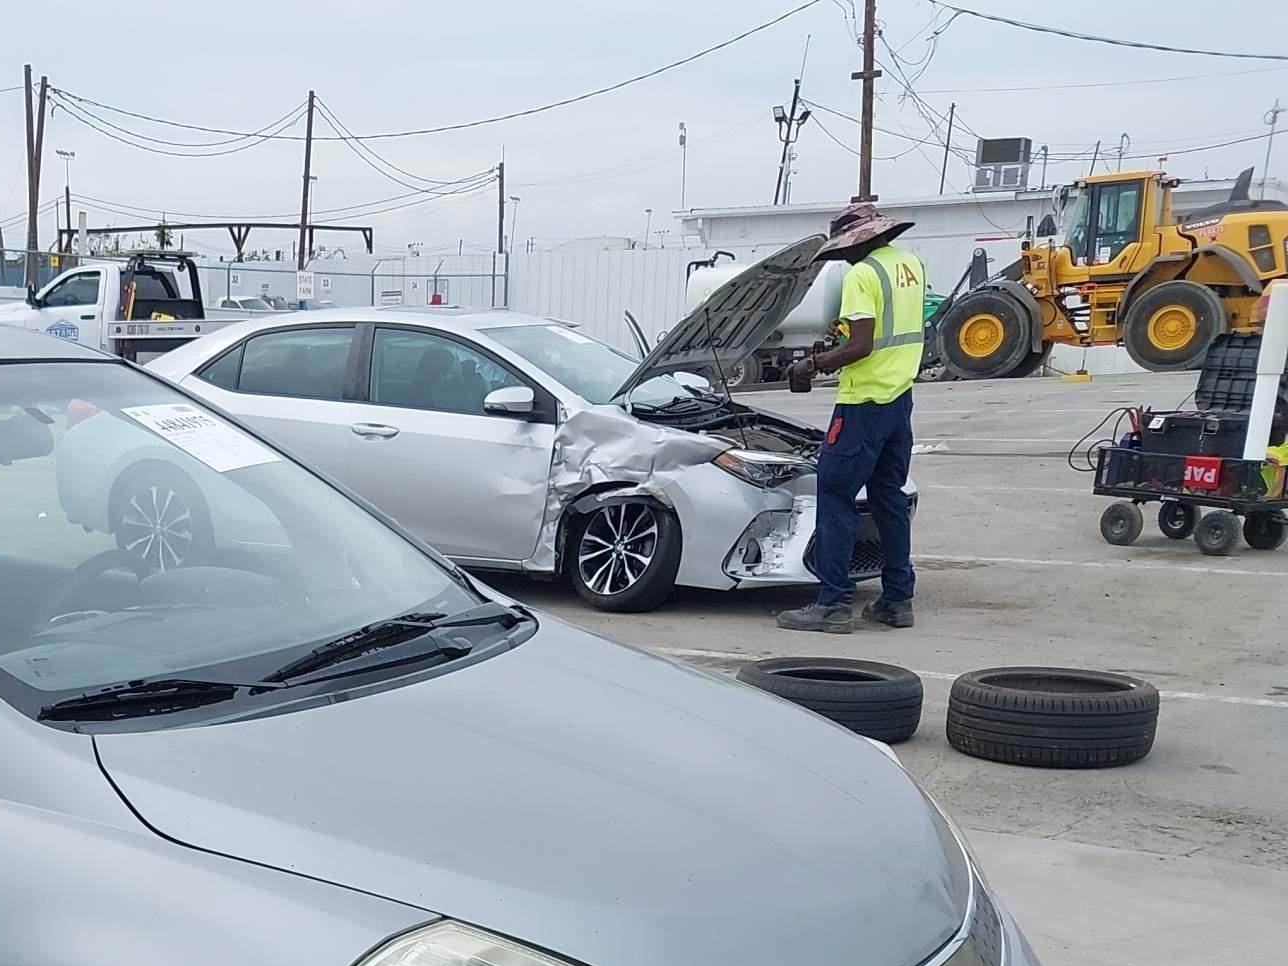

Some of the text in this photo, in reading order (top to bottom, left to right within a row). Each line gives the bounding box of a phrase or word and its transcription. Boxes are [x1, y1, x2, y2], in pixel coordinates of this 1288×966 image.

[1185, 218, 1220, 229] VOLVO
[231, 275, 239, 284] 32
[298, 275, 312, 285] STATE
[299, 287, 312, 296] FARM
